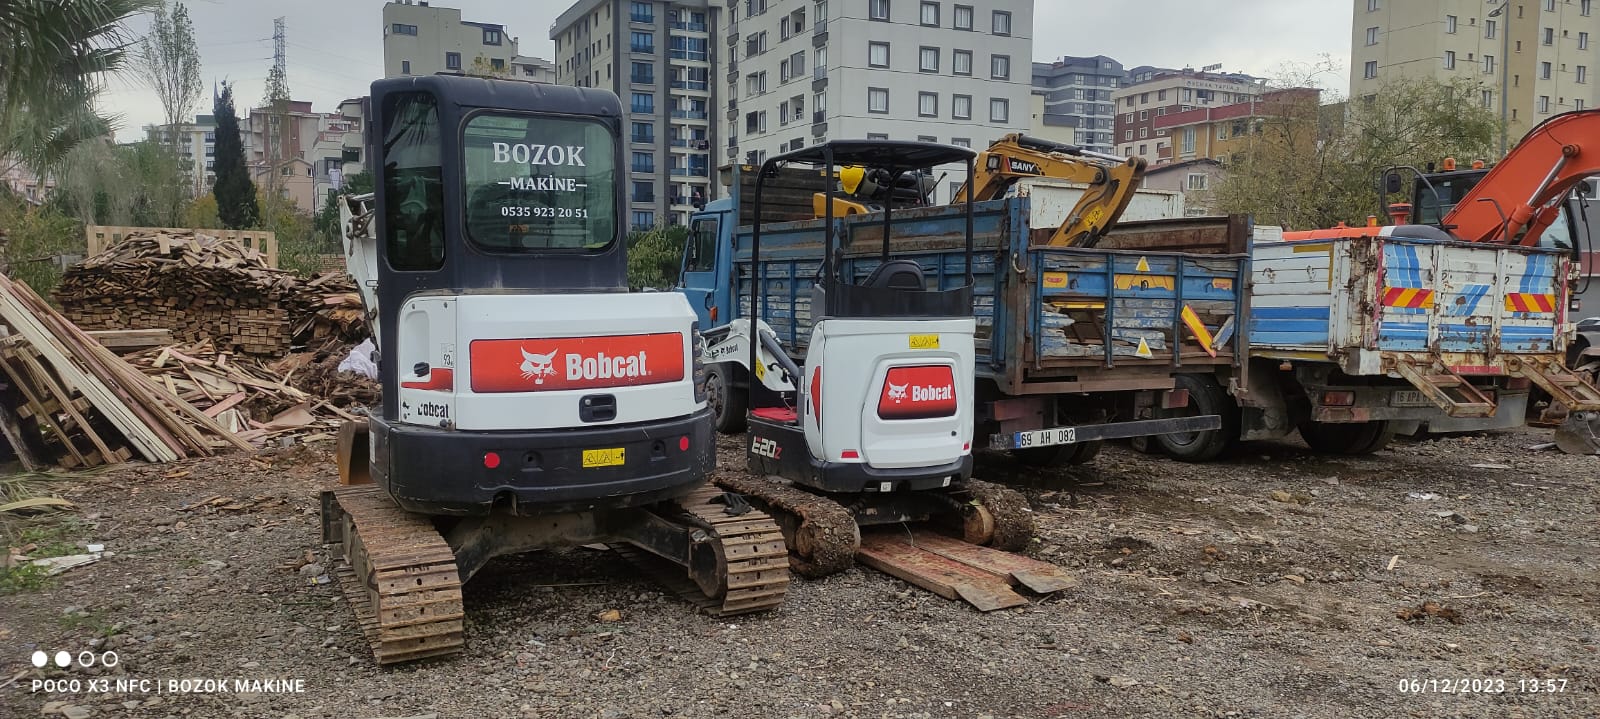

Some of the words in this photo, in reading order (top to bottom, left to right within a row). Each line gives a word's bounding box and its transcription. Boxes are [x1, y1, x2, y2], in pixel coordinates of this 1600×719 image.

[493, 142, 586, 167] BOZOK
[1011, 161, 1035, 172] SANY
[501, 206, 531, 217] 0535
[533, 207, 555, 217] 923
[558, 207, 572, 218] 20
[575, 208, 588, 218] 51
[566, 351, 646, 381] Bobcat
[912, 384, 952, 402] Bobcat
[1021, 433, 1032, 446] 69
[1040, 431, 1051, 445] AH
[1058, 429, 1075, 442] 082
